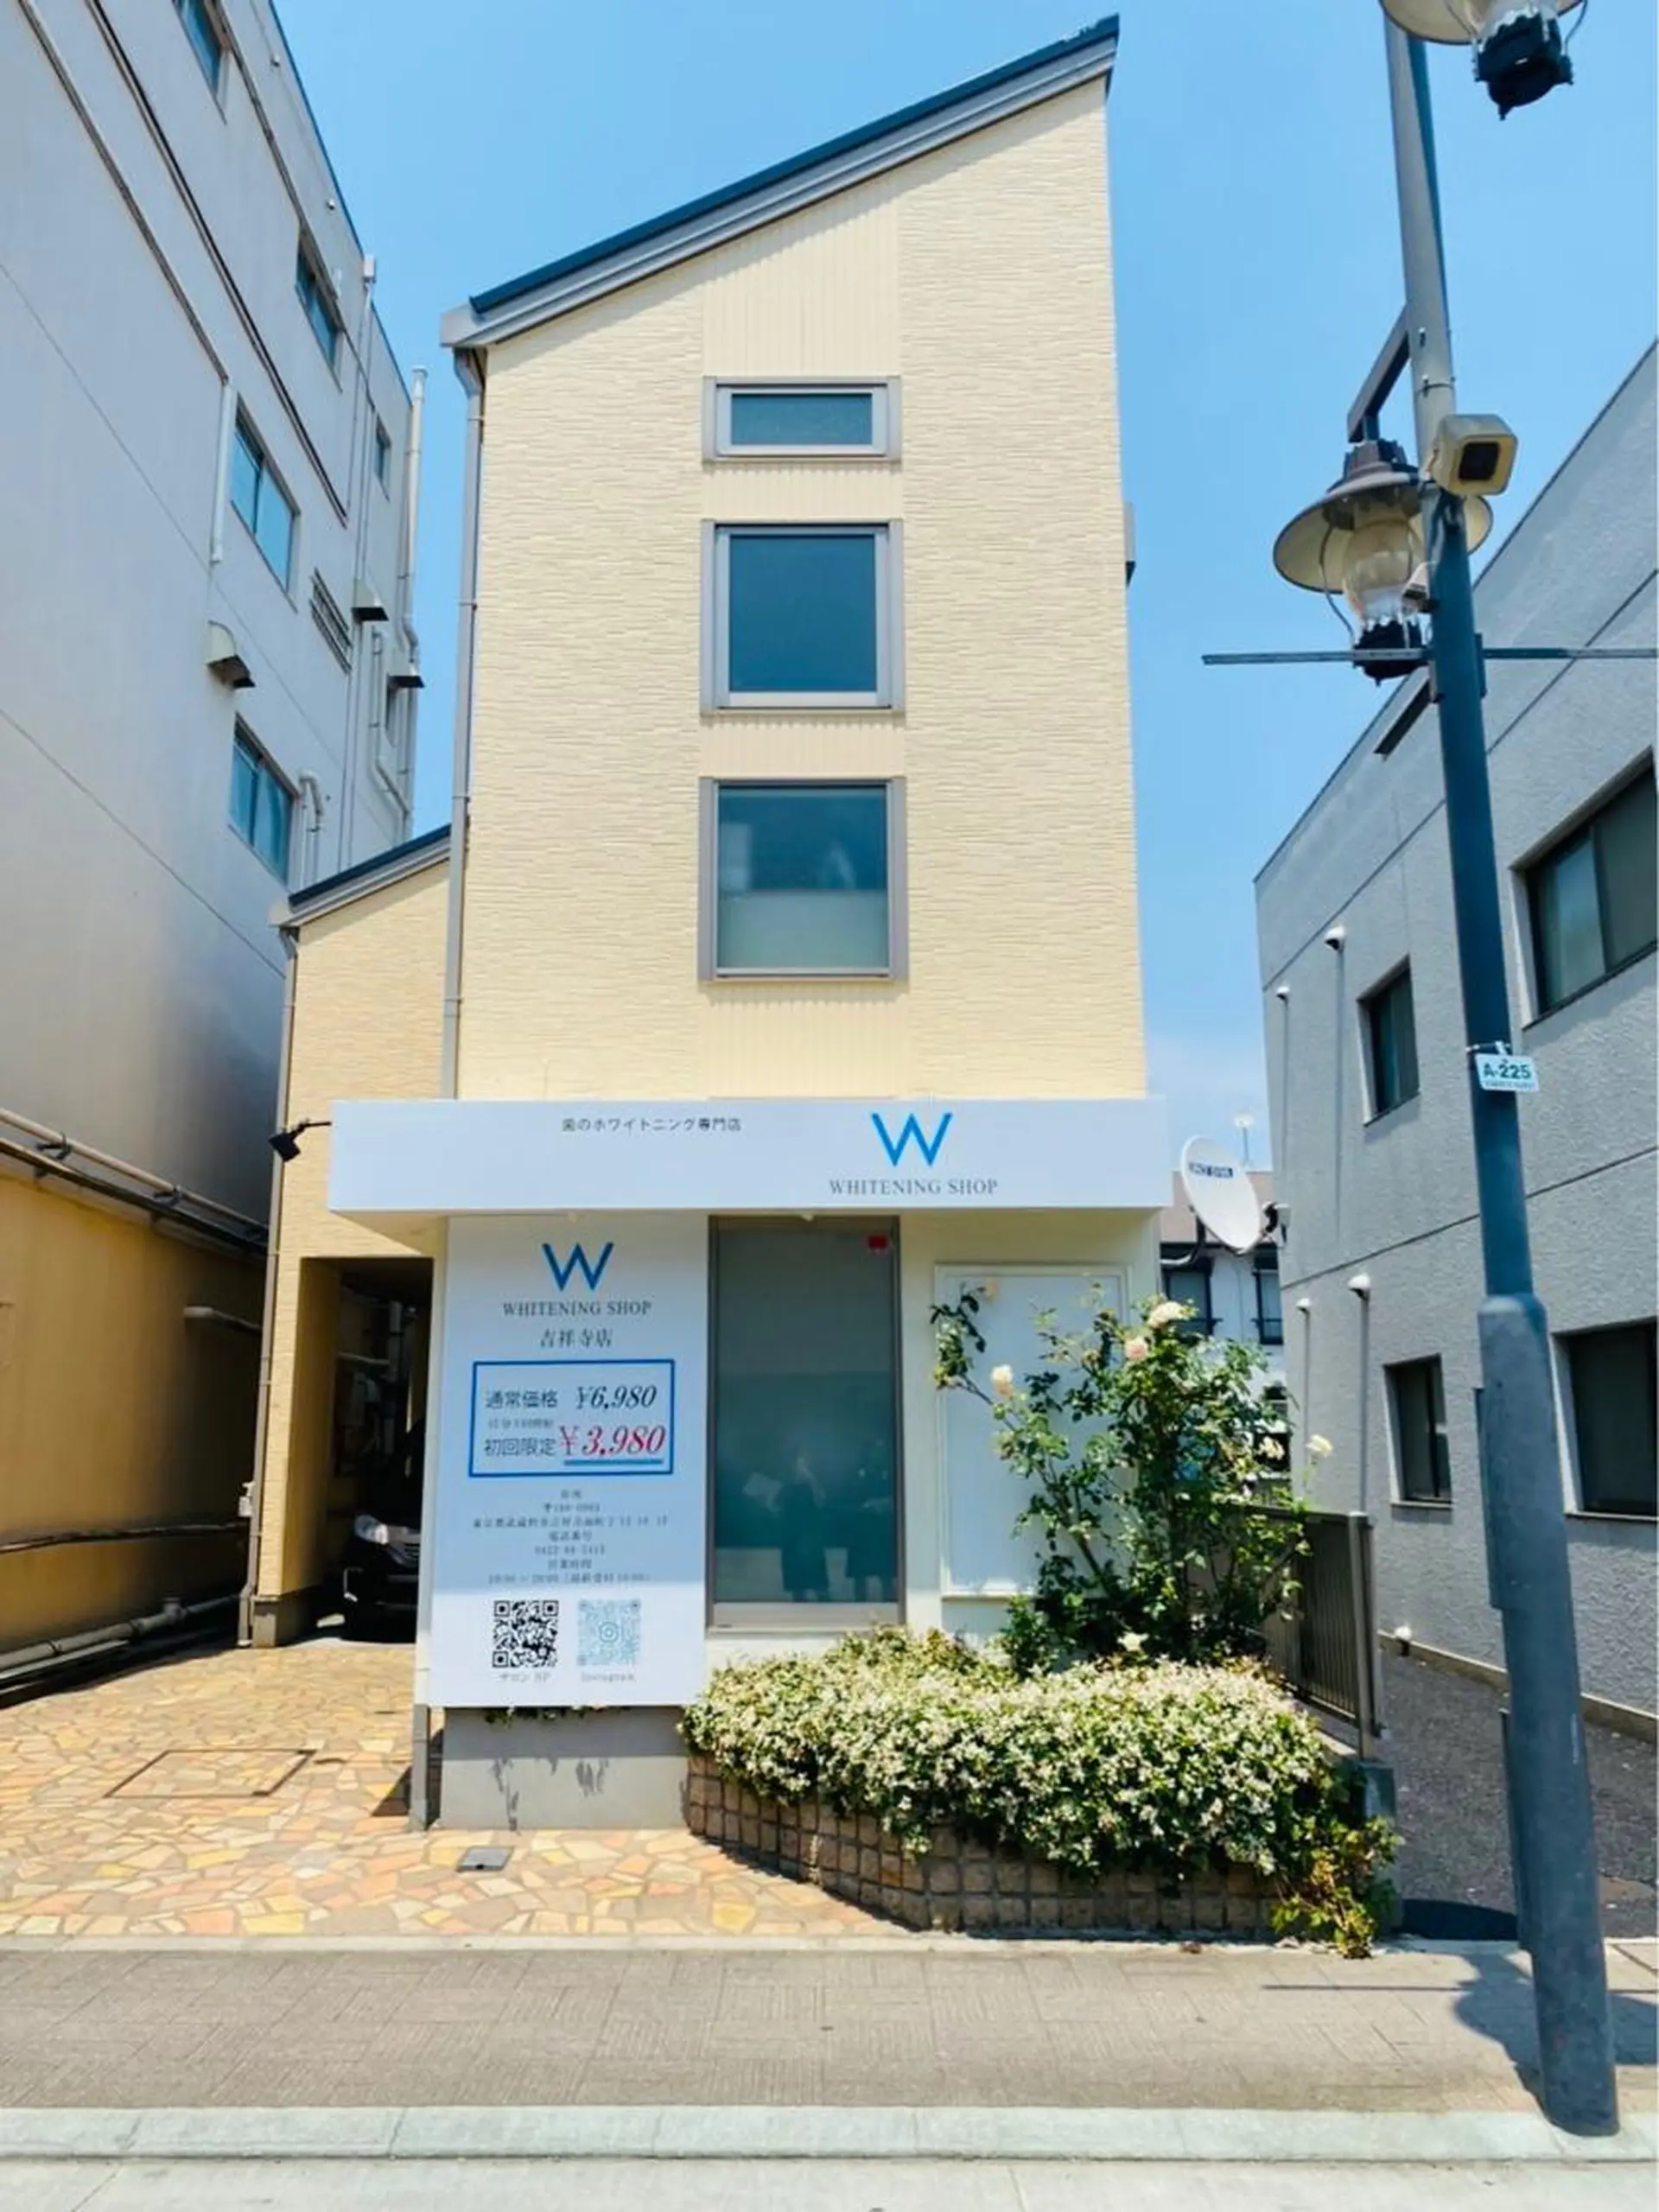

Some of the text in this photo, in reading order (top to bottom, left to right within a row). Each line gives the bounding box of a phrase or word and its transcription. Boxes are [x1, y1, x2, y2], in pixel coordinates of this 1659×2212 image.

[830, 1179, 998, 1196] WHITENING SHOP
[503, 1300, 652, 1316] WHITENING SHOP
[540, 1327, 613, 1348] 吉祥寺店
[486, 1389, 558, 1409] 通常価格
[484, 1438, 556, 1457] 初回限定
